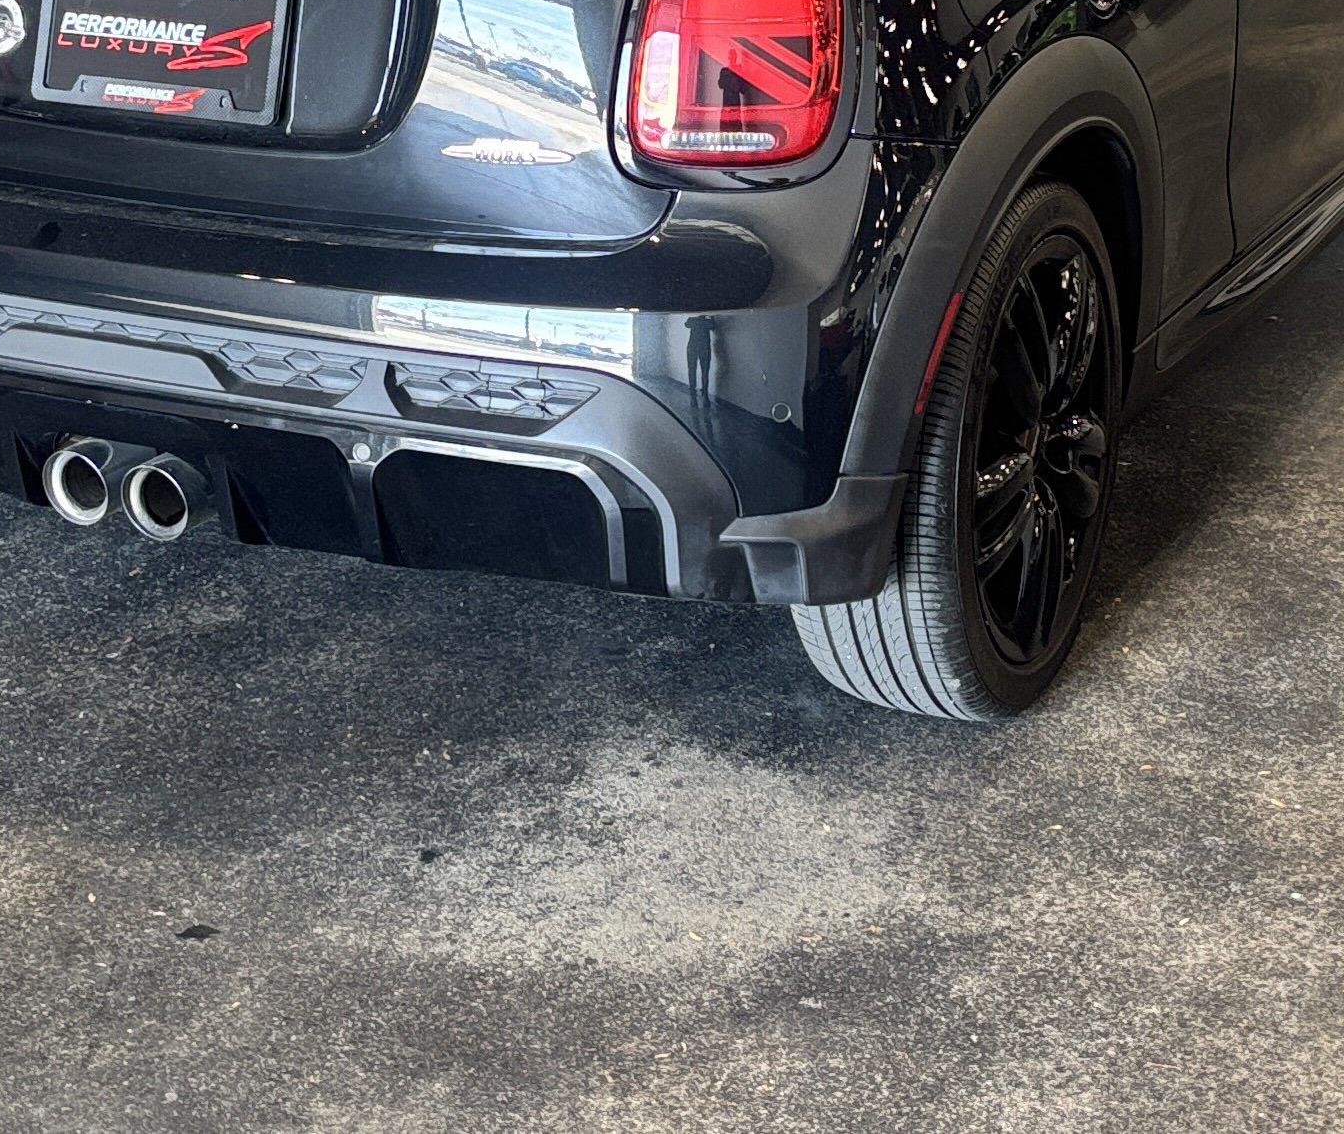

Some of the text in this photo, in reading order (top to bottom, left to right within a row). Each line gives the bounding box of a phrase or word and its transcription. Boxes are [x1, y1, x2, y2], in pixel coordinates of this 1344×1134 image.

[60, 11, 206, 46] PERFORMANCE
[58, 33, 199, 56] LUXURY
[474, 149, 537, 164] WORKS
